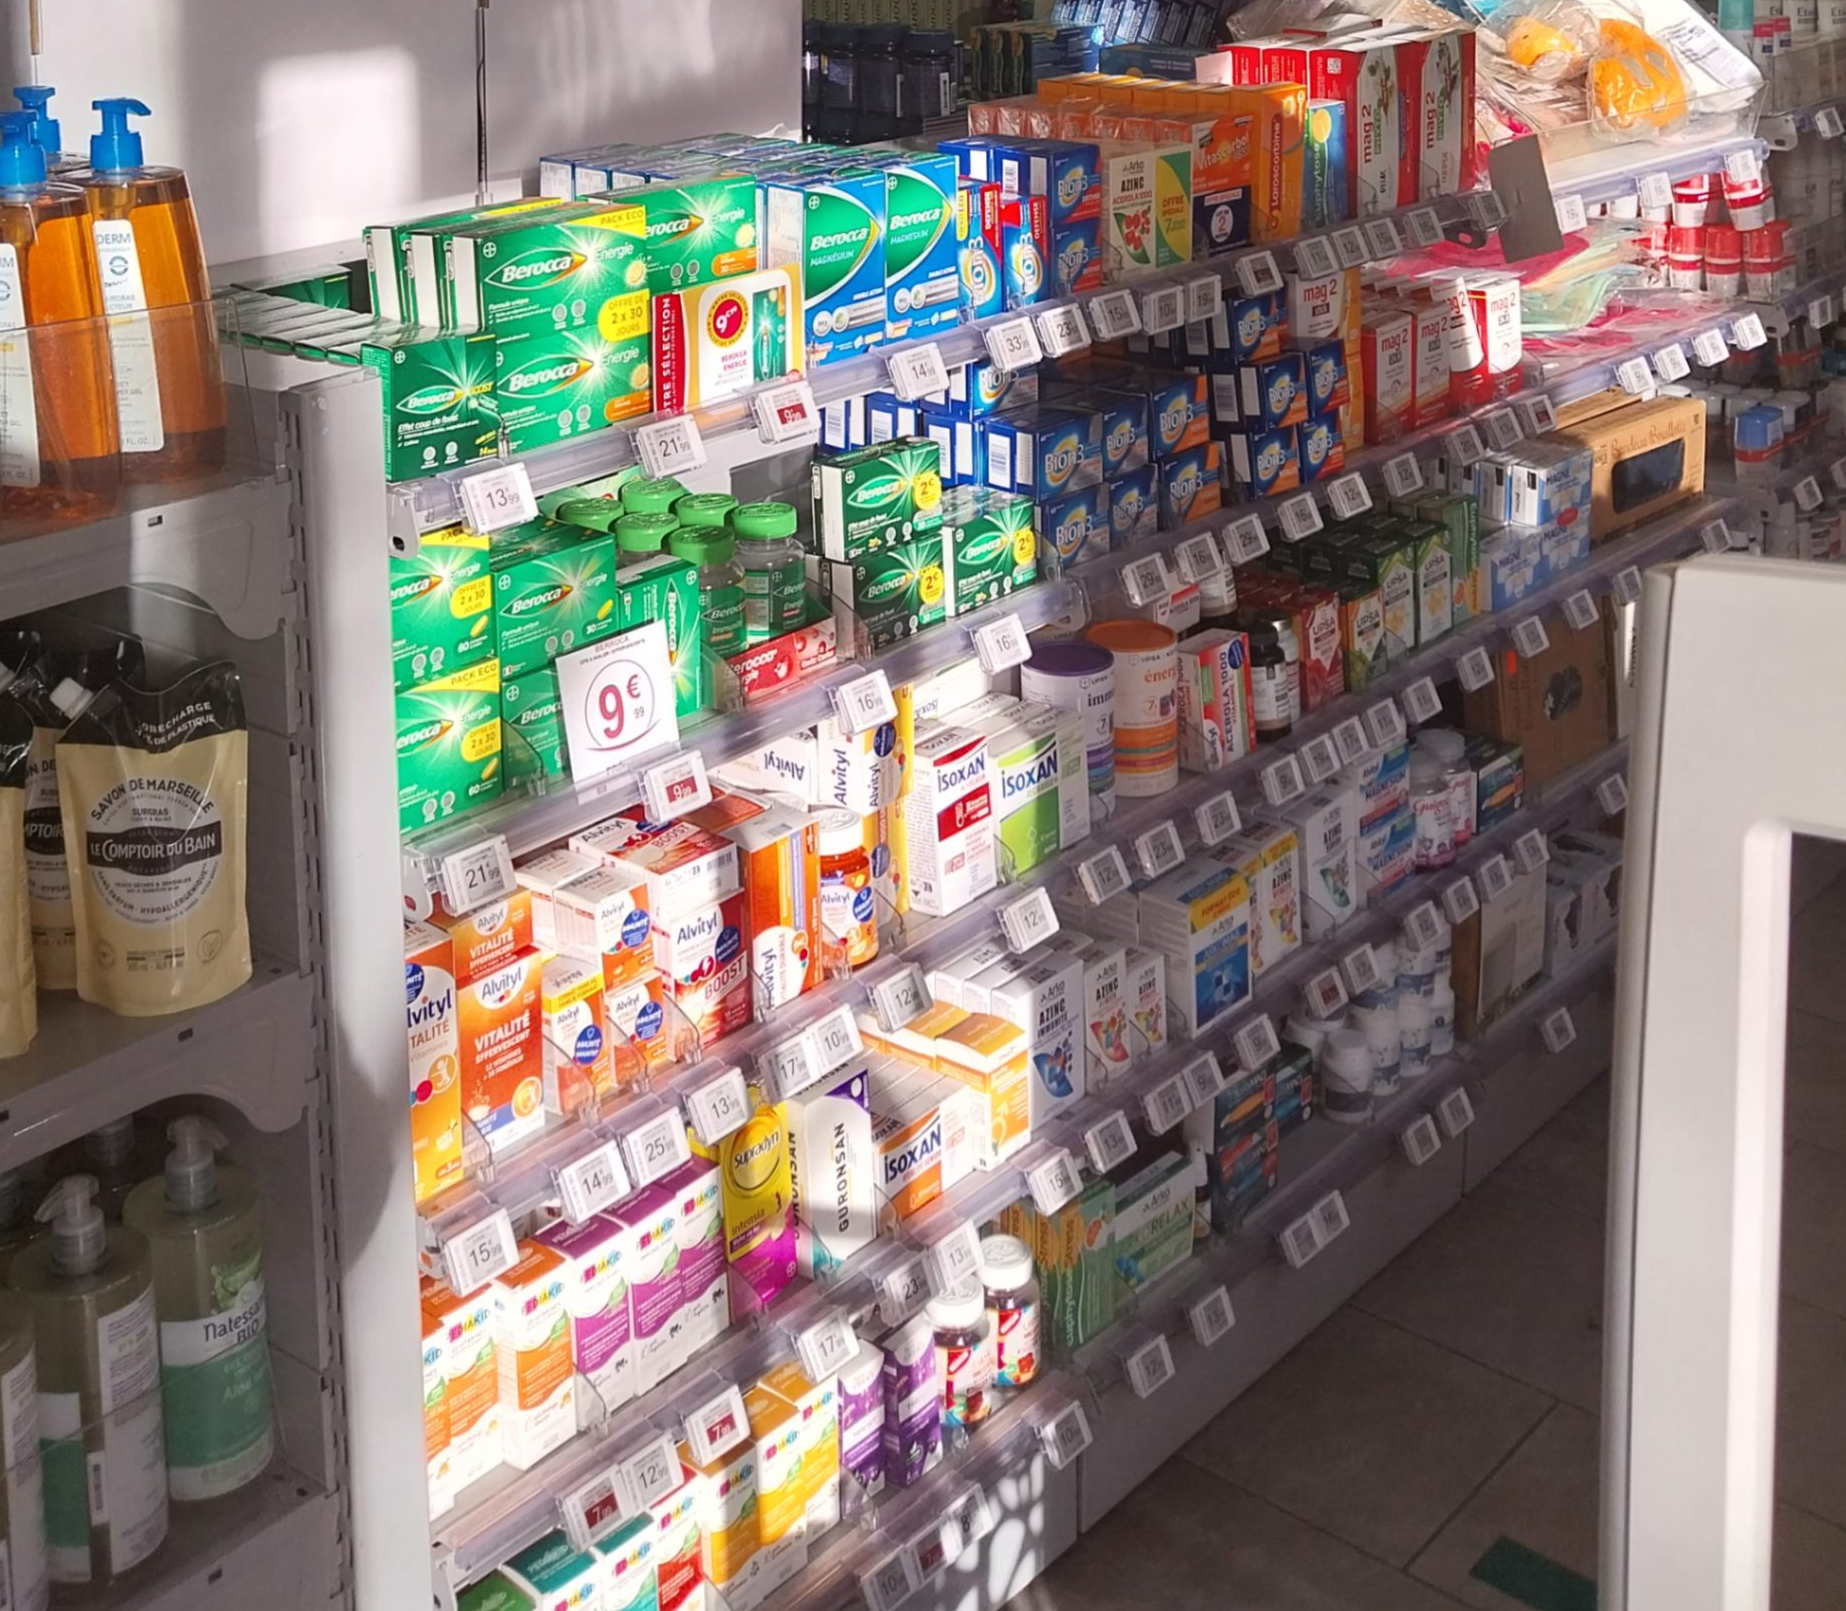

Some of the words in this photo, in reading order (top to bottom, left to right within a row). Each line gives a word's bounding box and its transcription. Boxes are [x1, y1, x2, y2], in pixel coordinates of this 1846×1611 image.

[1426, 91, 1435, 104] 2
[1362, 104, 1372, 117] 2
[1426, 108, 1436, 149] mag
[1363, 121, 1372, 164] mag
[1271, 121, 1281, 207] Laroscorbine
[1058, 175, 1088, 196] Bion3
[1121, 176, 1144, 193] AZINC
[1163, 195, 1184, 209] OFFRE
[626, 210, 643, 221] ECO
[645, 217, 690, 237] erocca
[890, 208, 942, 230] Berocca
[1218, 216, 1226, 232] 2
[97, 232, 131, 245] DERM
[810, 227, 869, 251] Berocca
[501, 254, 573, 283] Berocca
[609, 299, 631, 310] OFFRE
[634, 295, 644, 305] DE
[1305, 282, 1327, 303] mag
[1329, 279, 1338, 296] 2
[611, 313, 619, 325] 2
[630, 308, 642, 320] 30
[616, 324, 641, 336] JOURS
[662, 297, 671, 377] SÉLECTION
[508, 362, 578, 392] Berocca
[407, 391, 454, 409] Berocca
[1160, 404, 1193, 431] Bion3
[1106, 428, 1135, 452] Bion3
[1045, 444, 1083, 473] Bion3
[857, 481, 901, 502] Berocca
[966, 540, 1003, 560] Berocca
[868, 576, 906, 598] Berocca
[1386, 573, 1407, 589] UPSA
[461, 595, 467, 605] 2
[475, 590, 485, 600] 30
[512, 590, 562, 614] Berocca
[667, 592, 676, 651] Berocca
[1312, 619, 1336, 636] UPSA
[1357, 611, 1380, 629] UPSA
[458, 642, 469, 653] 60
[595, 635, 629, 653] BERROCA
[451, 671, 475, 685] PACK
[478, 663, 498, 676] ECO
[1220, 651, 1228, 686] 1000
[1223, 690, 1234, 752] ACEROLA
[471, 739, 478, 749] 2
[485, 733, 496, 744] 30
[42, 759, 56, 772] DE
[764, 750, 805, 781] Alvityl
[834, 749, 850, 806] Alvityl
[469, 786, 480, 796] 60
[870, 762, 881, 807] Alvityl
[91, 782, 126, 820] SAVON
[129, 778, 145, 791] DE
[147, 779, 214, 814] MARSEILLE
[132, 808, 169, 817] SURGRAS
[581, 819, 626, 843] Alvityl
[653, 823, 690, 849] BOOST
[91, 842, 101, 857] LE
[102, 839, 164, 862] COMPTOIR
[168, 842, 183, 856] DU
[185, 833, 216, 855] BAIN
[1272, 868, 1292, 889] AZINC
[108, 889, 135, 911] PARFUM
[601, 901, 625, 919] Alvityl
[477, 910, 505, 929] Alvityl
[677, 912, 718, 944] Alvityl
[469, 928, 514, 958] VITALITÉ
[481, 968, 522, 1000] Alvityl
[704, 956, 745, 1001] BOOST
[1047, 981, 1065, 999] Arko
[1138, 977, 1157, 996] AZINC
[1095, 980, 1119, 1002] AZINC
[407, 988, 452, 1028] lvityl
[557, 1006, 579, 1025] Alvityl
[616, 994, 640, 1013] Alvityl
[1039, 998, 1067, 1027] AZINC
[410, 1018, 450, 1049] TALITÉ
[474, 1010, 530, 1051] VITALITÉ
[475, 1030, 531, 1064] EFFERVESCENT
[734, 1130, 779, 1170] Supradyn
[833, 1122, 850, 1234] GURONSAN
[680, 1185, 718, 1217] EDIAKID
[637, 1217, 675, 1251] EDIAKID
[1065, 1218, 1074, 1266] Stress
[580, 1250, 622, 1284] EDIAKID
[521, 1280, 565, 1316] EDIAKID
[237, 1319, 259, 1344] BIO
[447, 1307, 490, 1344] EDIAKID
